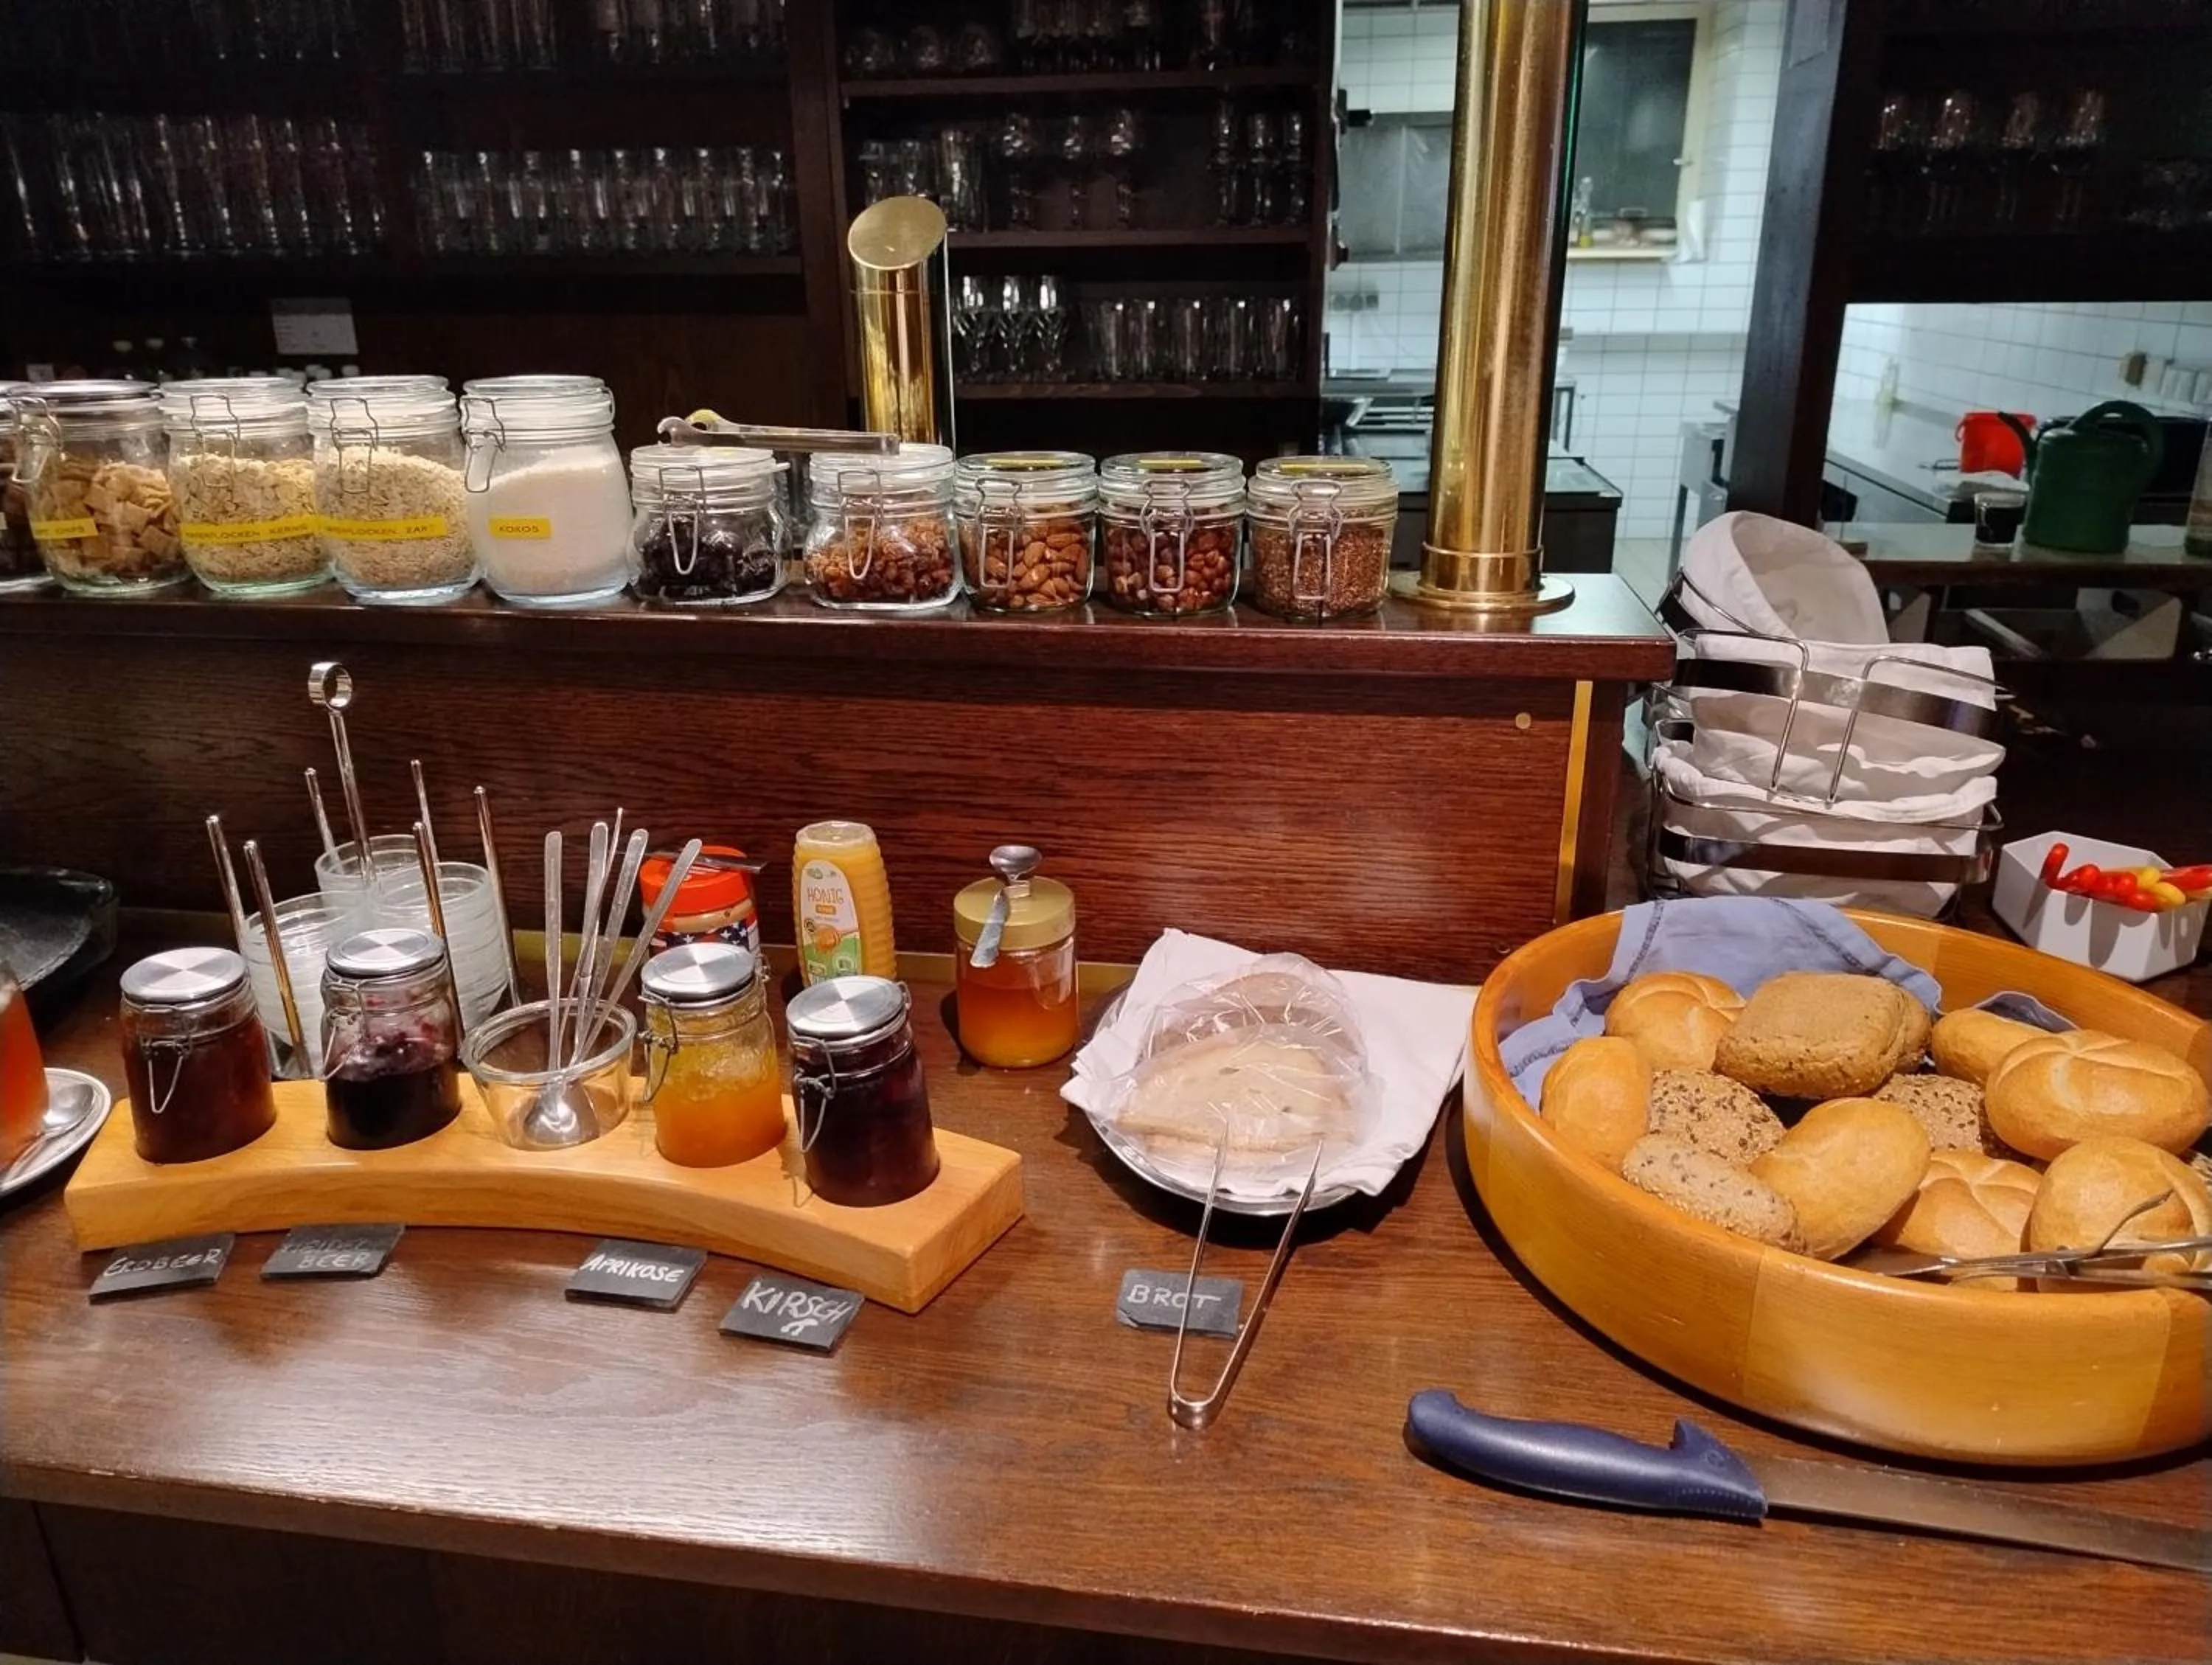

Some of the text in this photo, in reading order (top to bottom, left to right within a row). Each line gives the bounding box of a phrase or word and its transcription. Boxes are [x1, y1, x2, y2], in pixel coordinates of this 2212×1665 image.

[498, 524, 540, 533] KOKOS
[806, 886, 845, 905] HONIG
[102, 1248, 221, 1277] ERDBEER
[297, 1252, 371, 1270] BEER
[578, 1253, 685, 1283] APRIKOSE
[740, 1280, 854, 1324] KIRSCH
[1126, 1283, 1222, 1310] BROT
